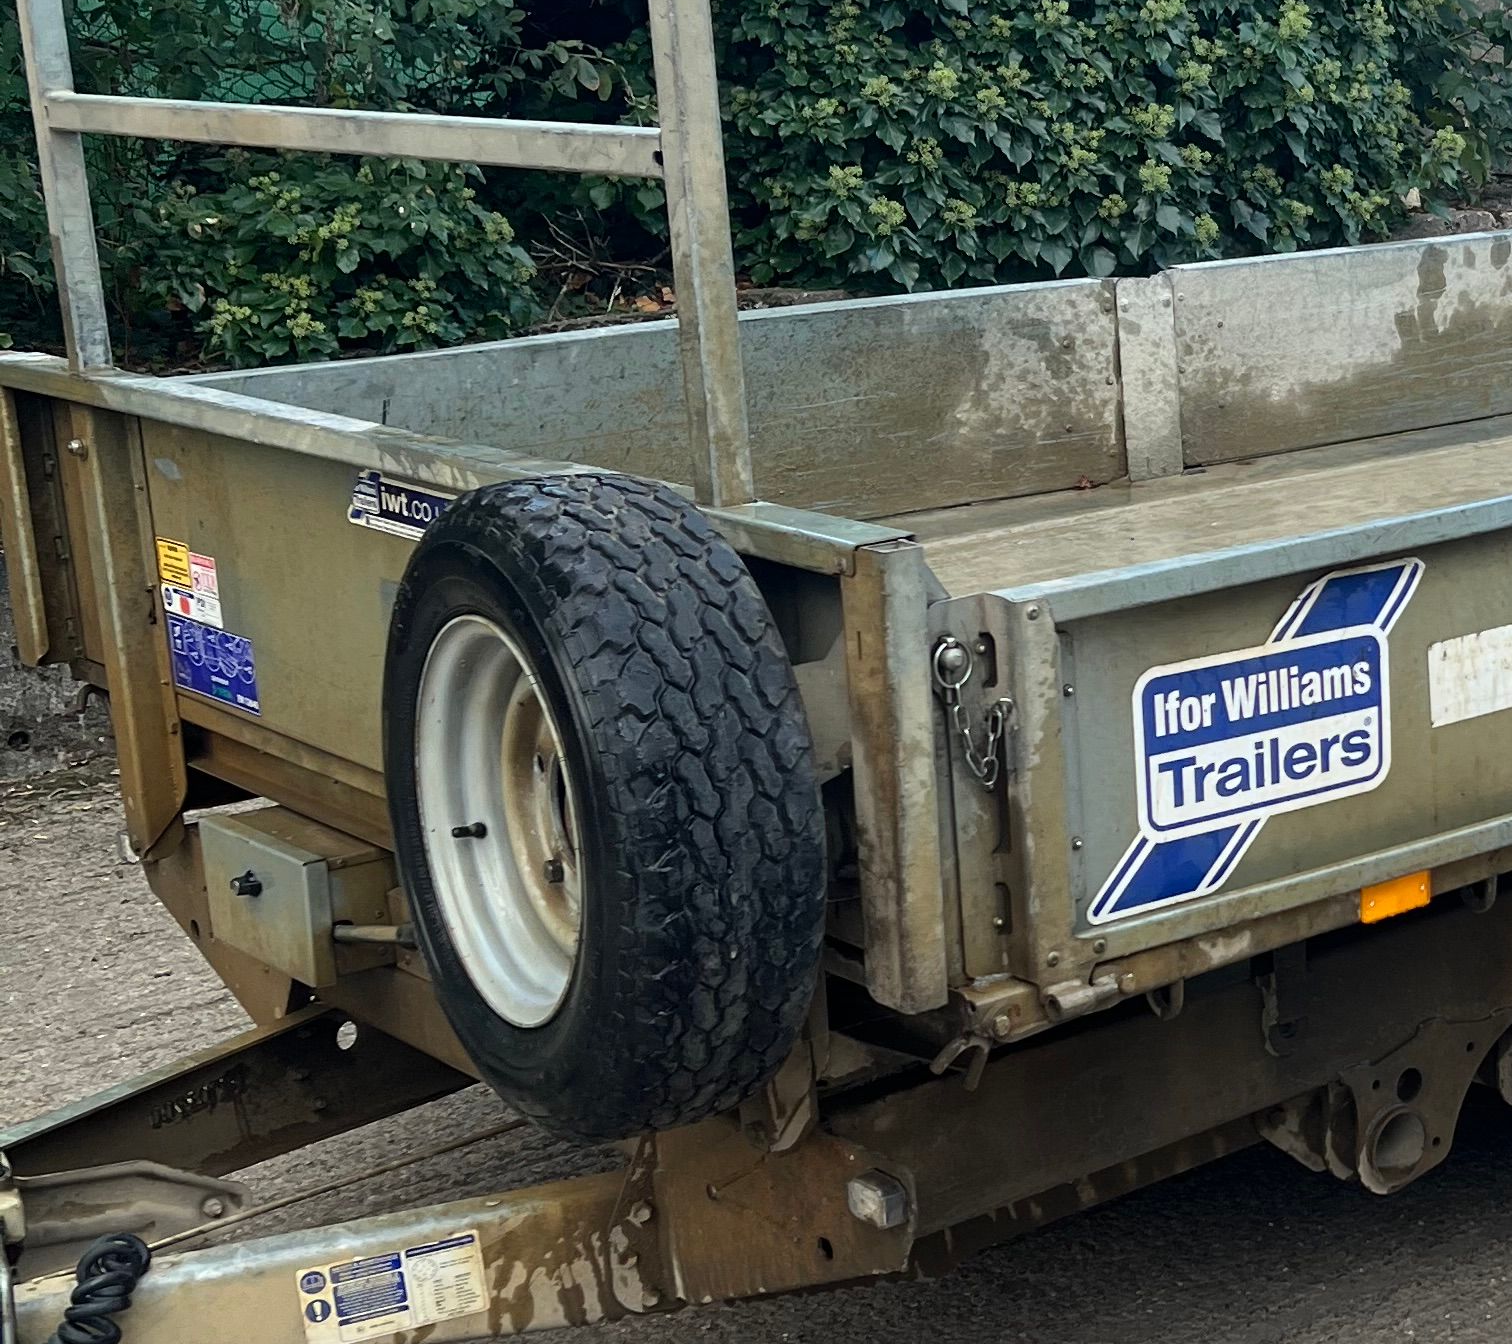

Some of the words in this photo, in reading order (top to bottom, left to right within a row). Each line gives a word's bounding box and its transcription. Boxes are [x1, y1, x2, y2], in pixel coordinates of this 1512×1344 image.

[1154, 688, 1215, 737] Ifor
[1221, 661, 1371, 721] Williams
[1158, 729, 1371, 807] Trailers
